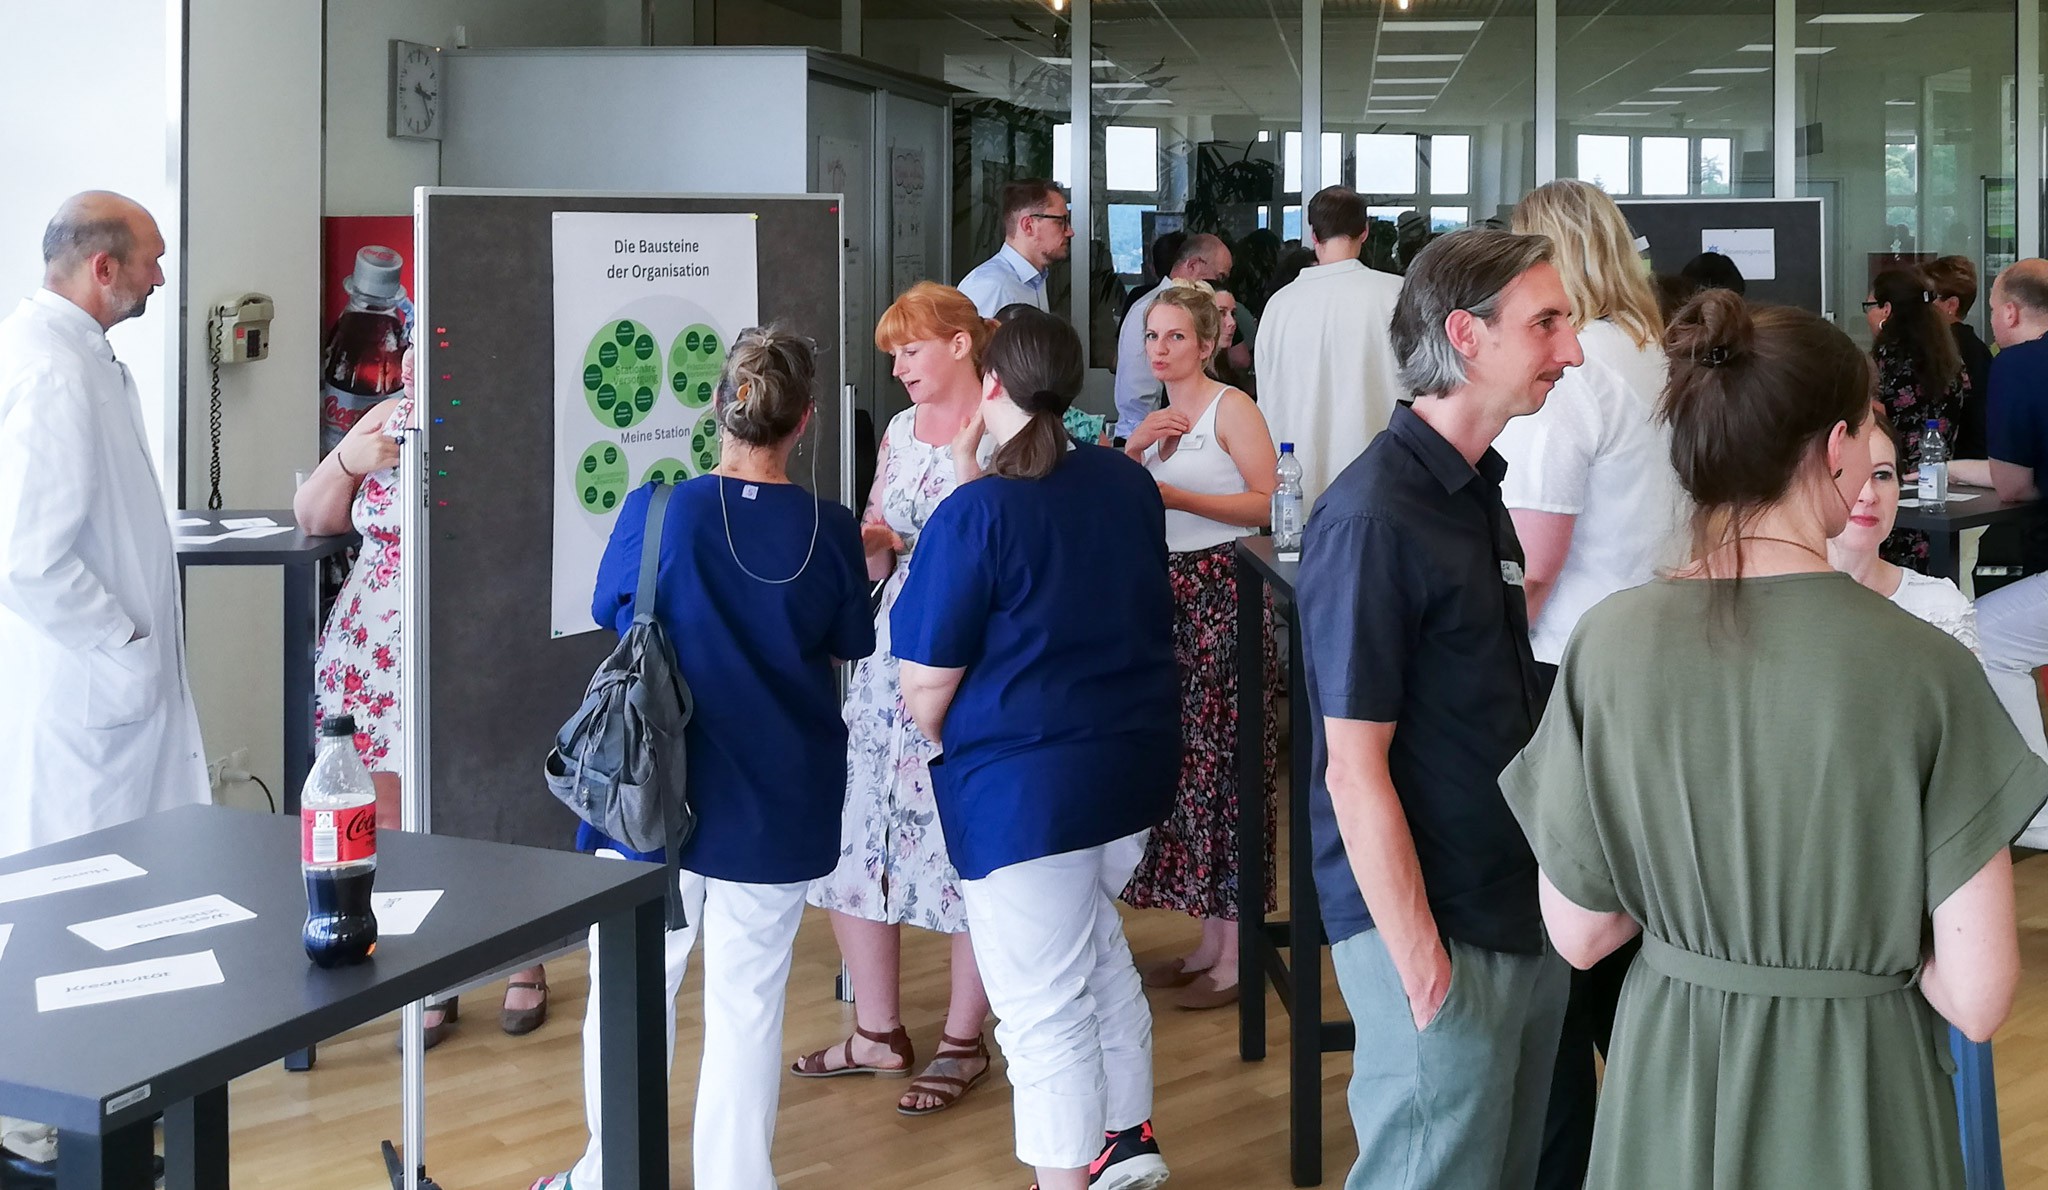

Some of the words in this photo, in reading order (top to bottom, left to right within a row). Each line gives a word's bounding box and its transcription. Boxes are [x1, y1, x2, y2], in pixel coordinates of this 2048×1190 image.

[614, 239, 635, 253] Die
[639, 239, 699, 253] Bausteine
[607, 264, 629, 278] der
[632, 262, 709, 281] Organisation
[621, 430, 652, 444] Meine
[655, 426, 691, 440] Station
[65, 970, 172, 993] Kreativität
